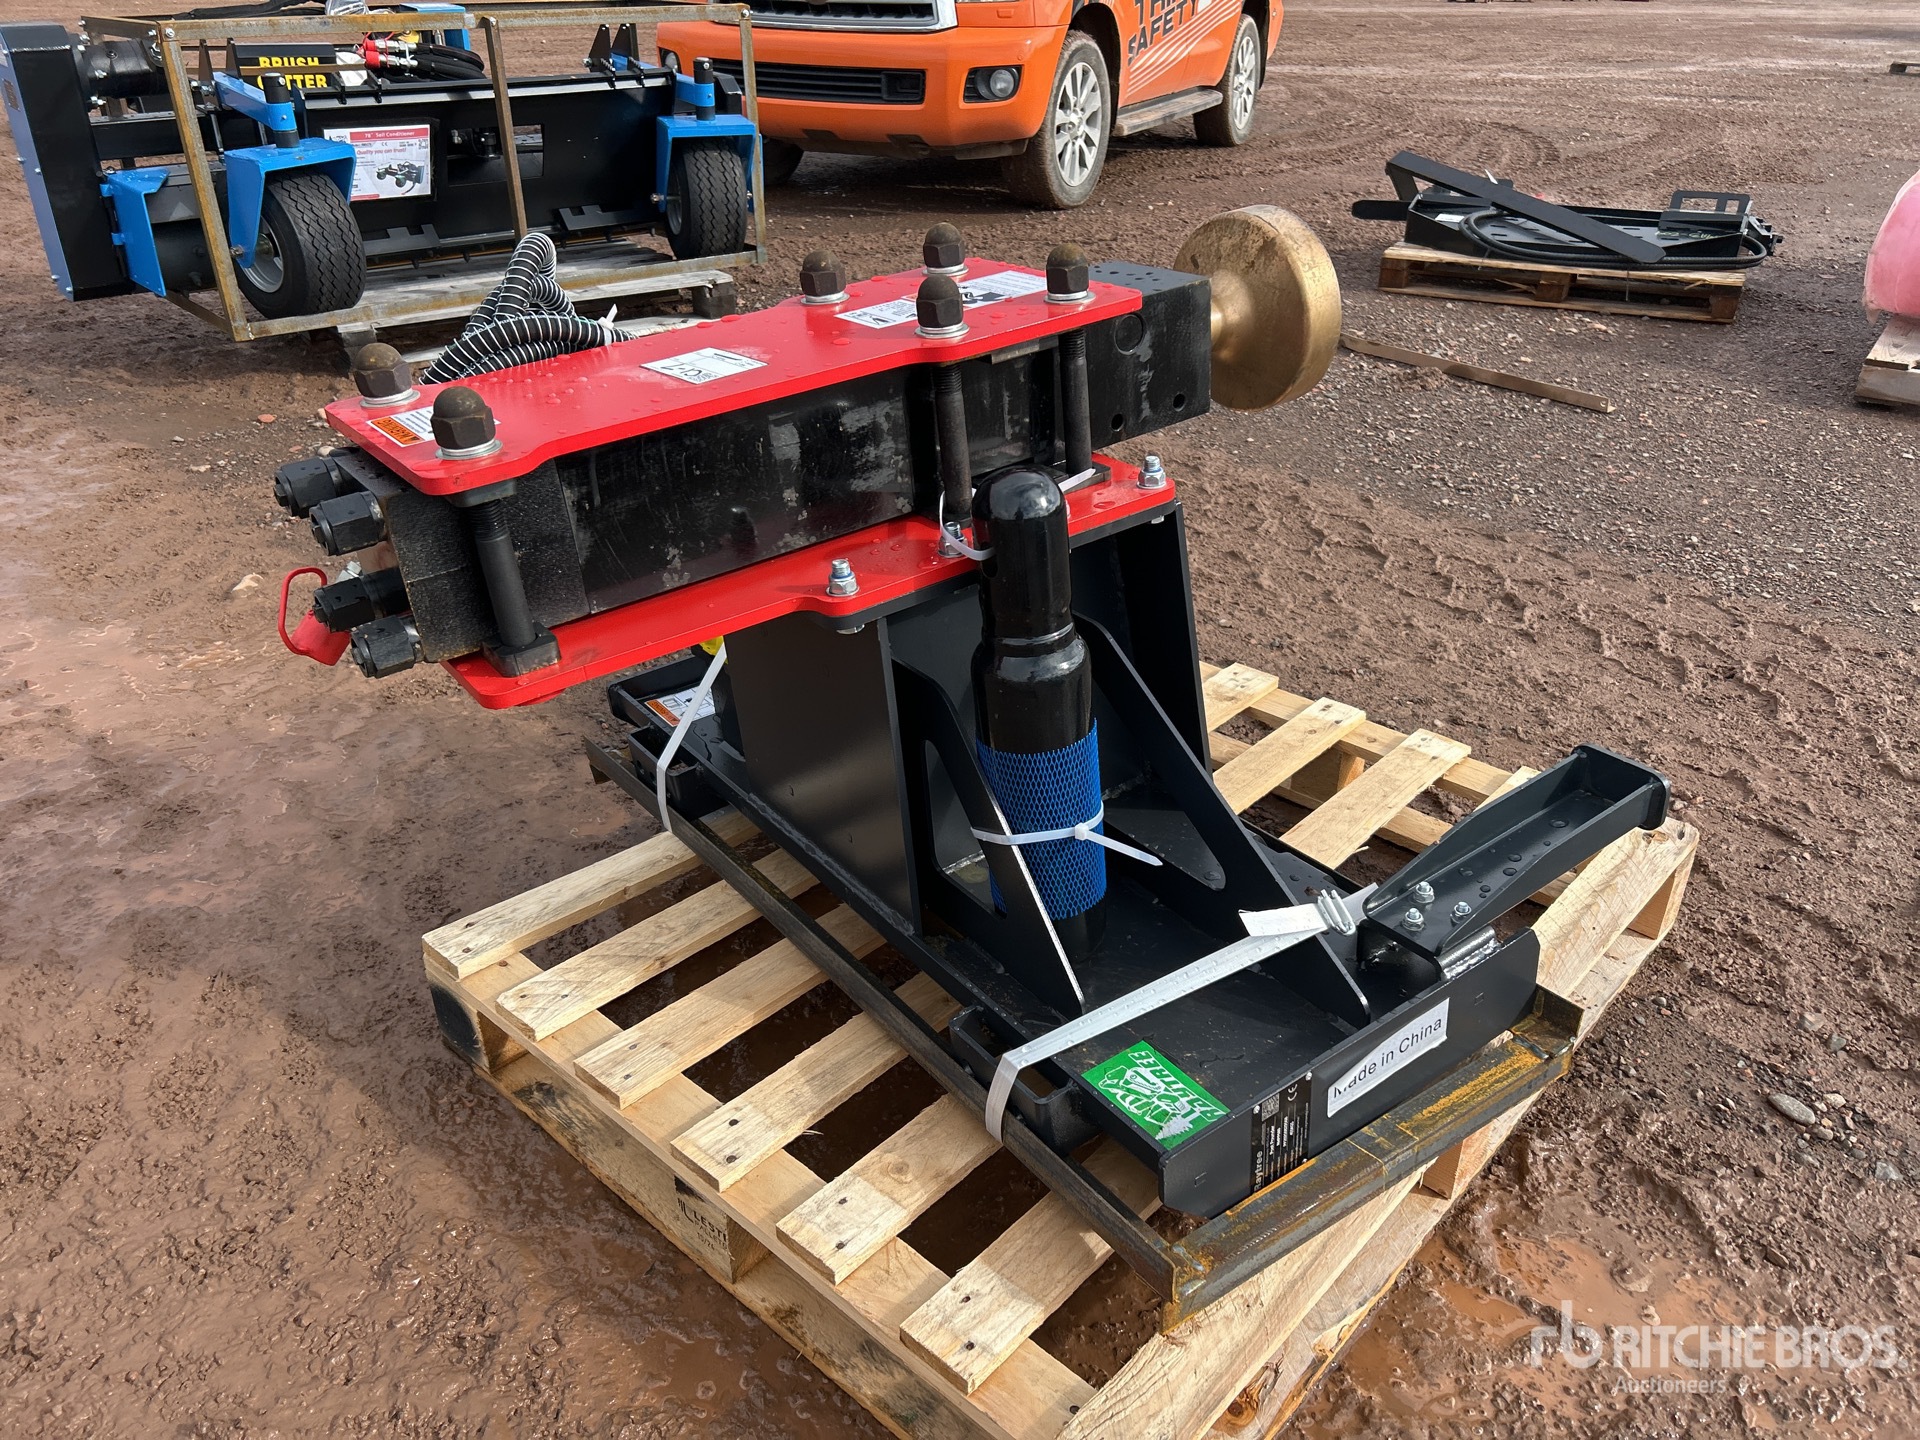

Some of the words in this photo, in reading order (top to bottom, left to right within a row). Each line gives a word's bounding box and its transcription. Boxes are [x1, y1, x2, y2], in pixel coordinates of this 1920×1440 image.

[1128, 0, 1196, 66] SAFETY
[1381, 1050, 1394, 1066] in
[1398, 1018, 1442, 1053] China
[1128, 1051, 1227, 1122] RAYTREE
[1254, 1150, 1264, 1192] Raytree
